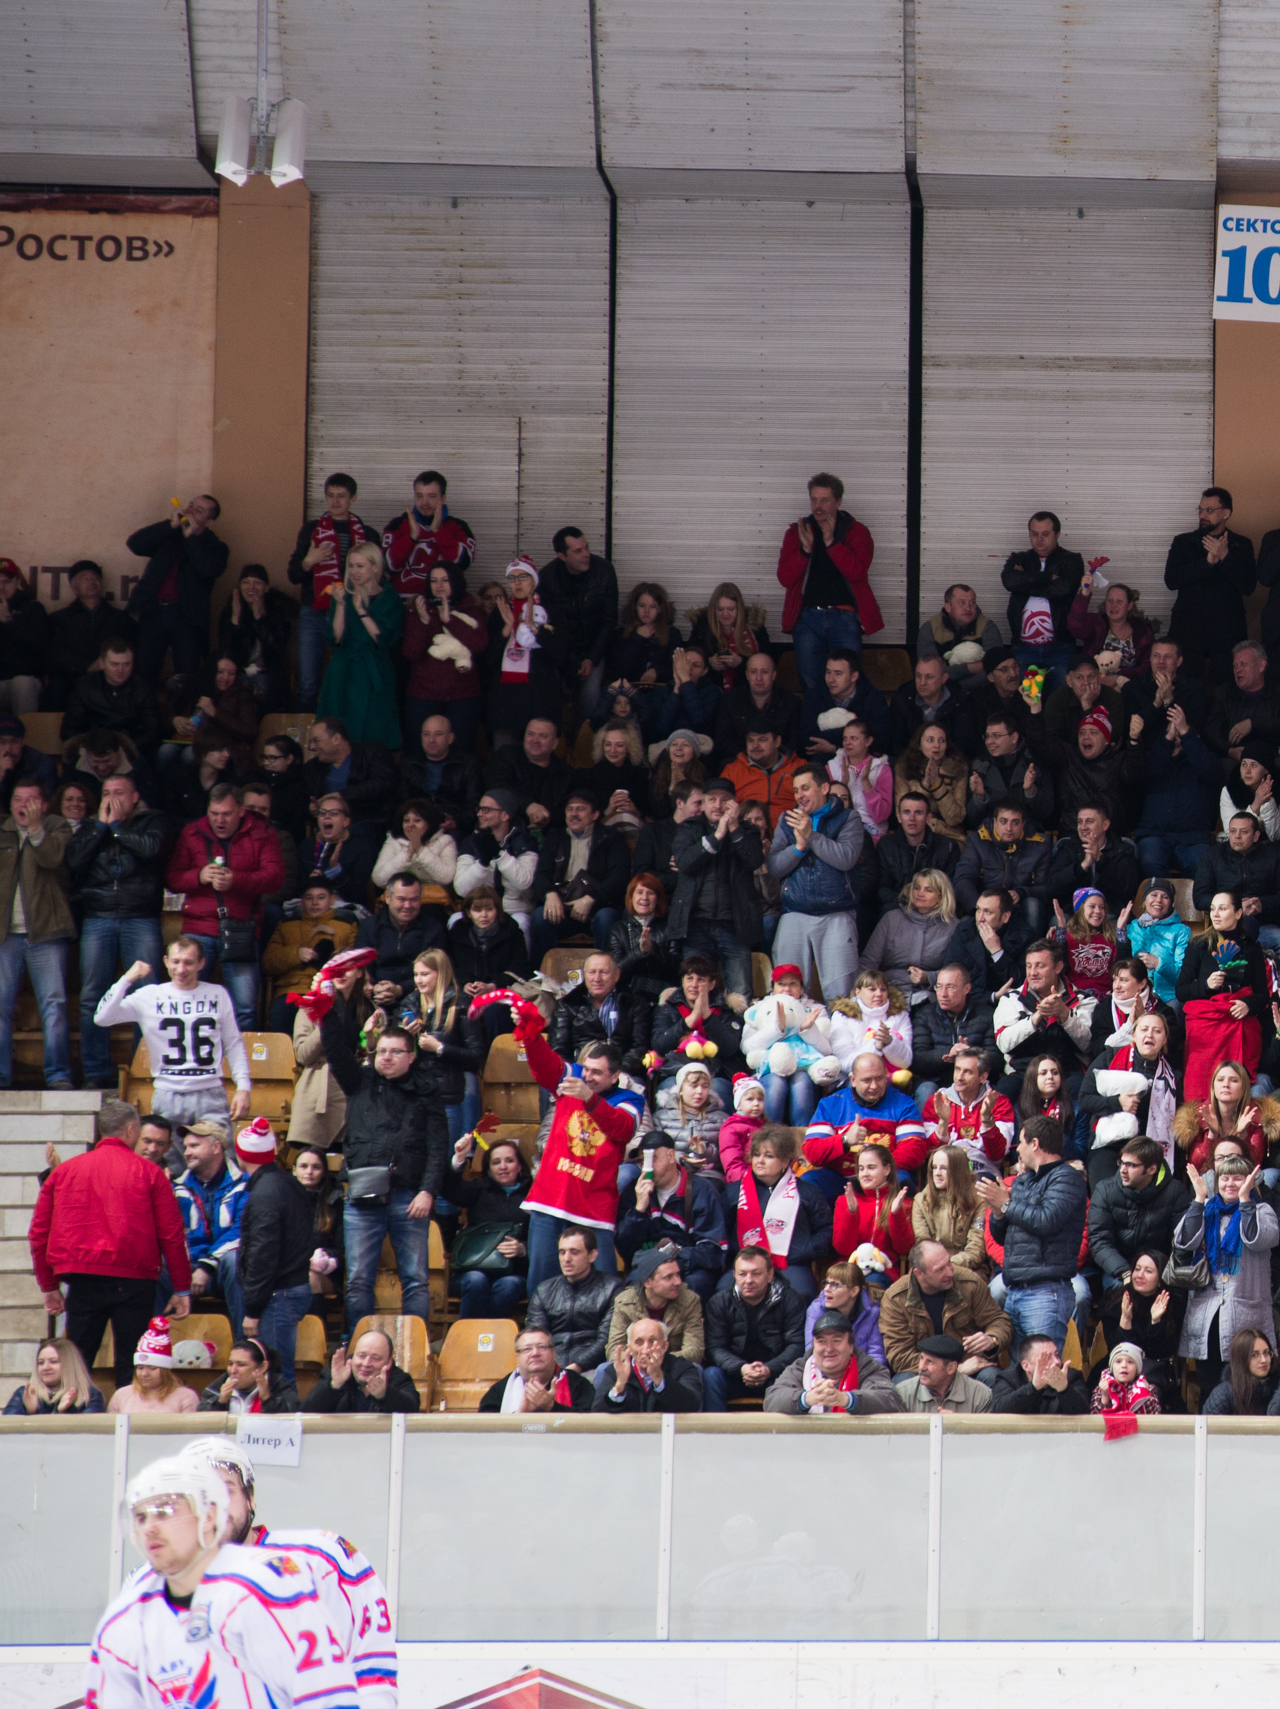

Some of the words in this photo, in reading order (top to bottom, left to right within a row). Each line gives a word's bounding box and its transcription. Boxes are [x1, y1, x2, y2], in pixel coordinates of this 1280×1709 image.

[158, 1017, 217, 1066] 36
[240, 1433, 282, 1449] Литер
[285, 1437, 295, 1447] А
